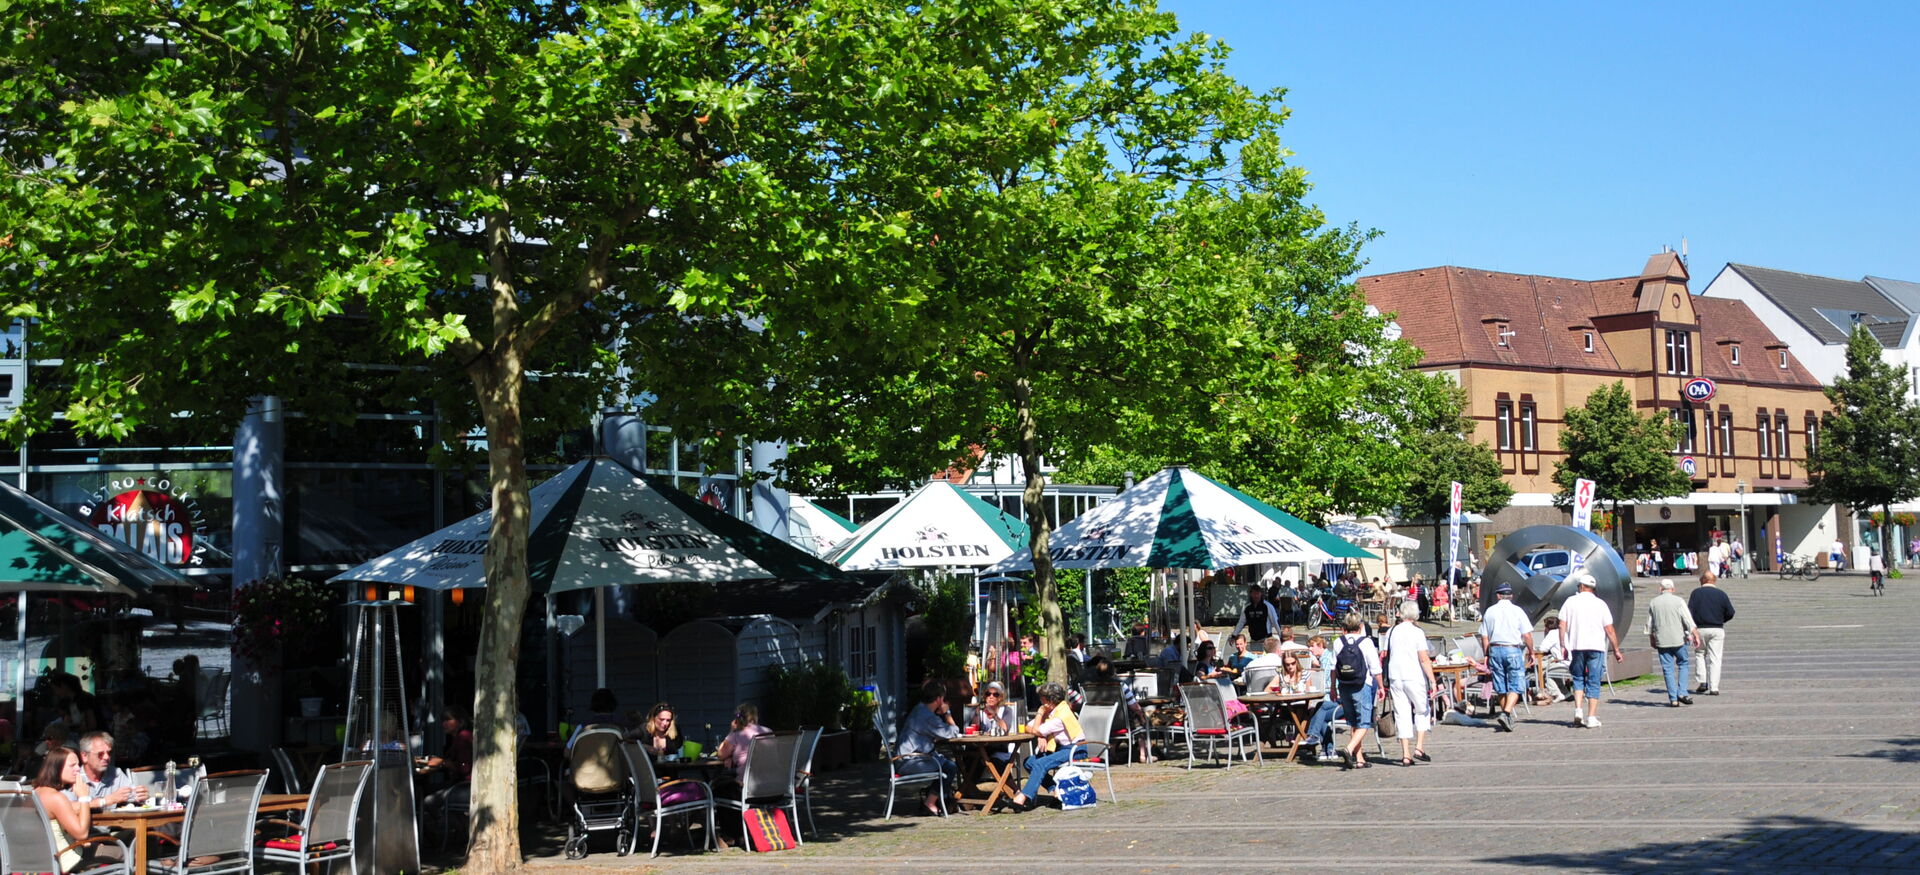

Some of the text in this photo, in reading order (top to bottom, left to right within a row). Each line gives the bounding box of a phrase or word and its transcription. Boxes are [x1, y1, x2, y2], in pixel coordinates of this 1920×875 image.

[1688, 383, 1709, 396] C&A
[79, 476, 135, 517] BISTRO
[107, 503, 175, 522] Klatsch
[430, 539, 489, 555] HOLST
[598, 534, 710, 552] HOLSTEN
[1219, 539, 1303, 556] HOLSTEN
[881, 544, 990, 560] HOLSTEN
[1029, 544, 1134, 562] OLSTEN
